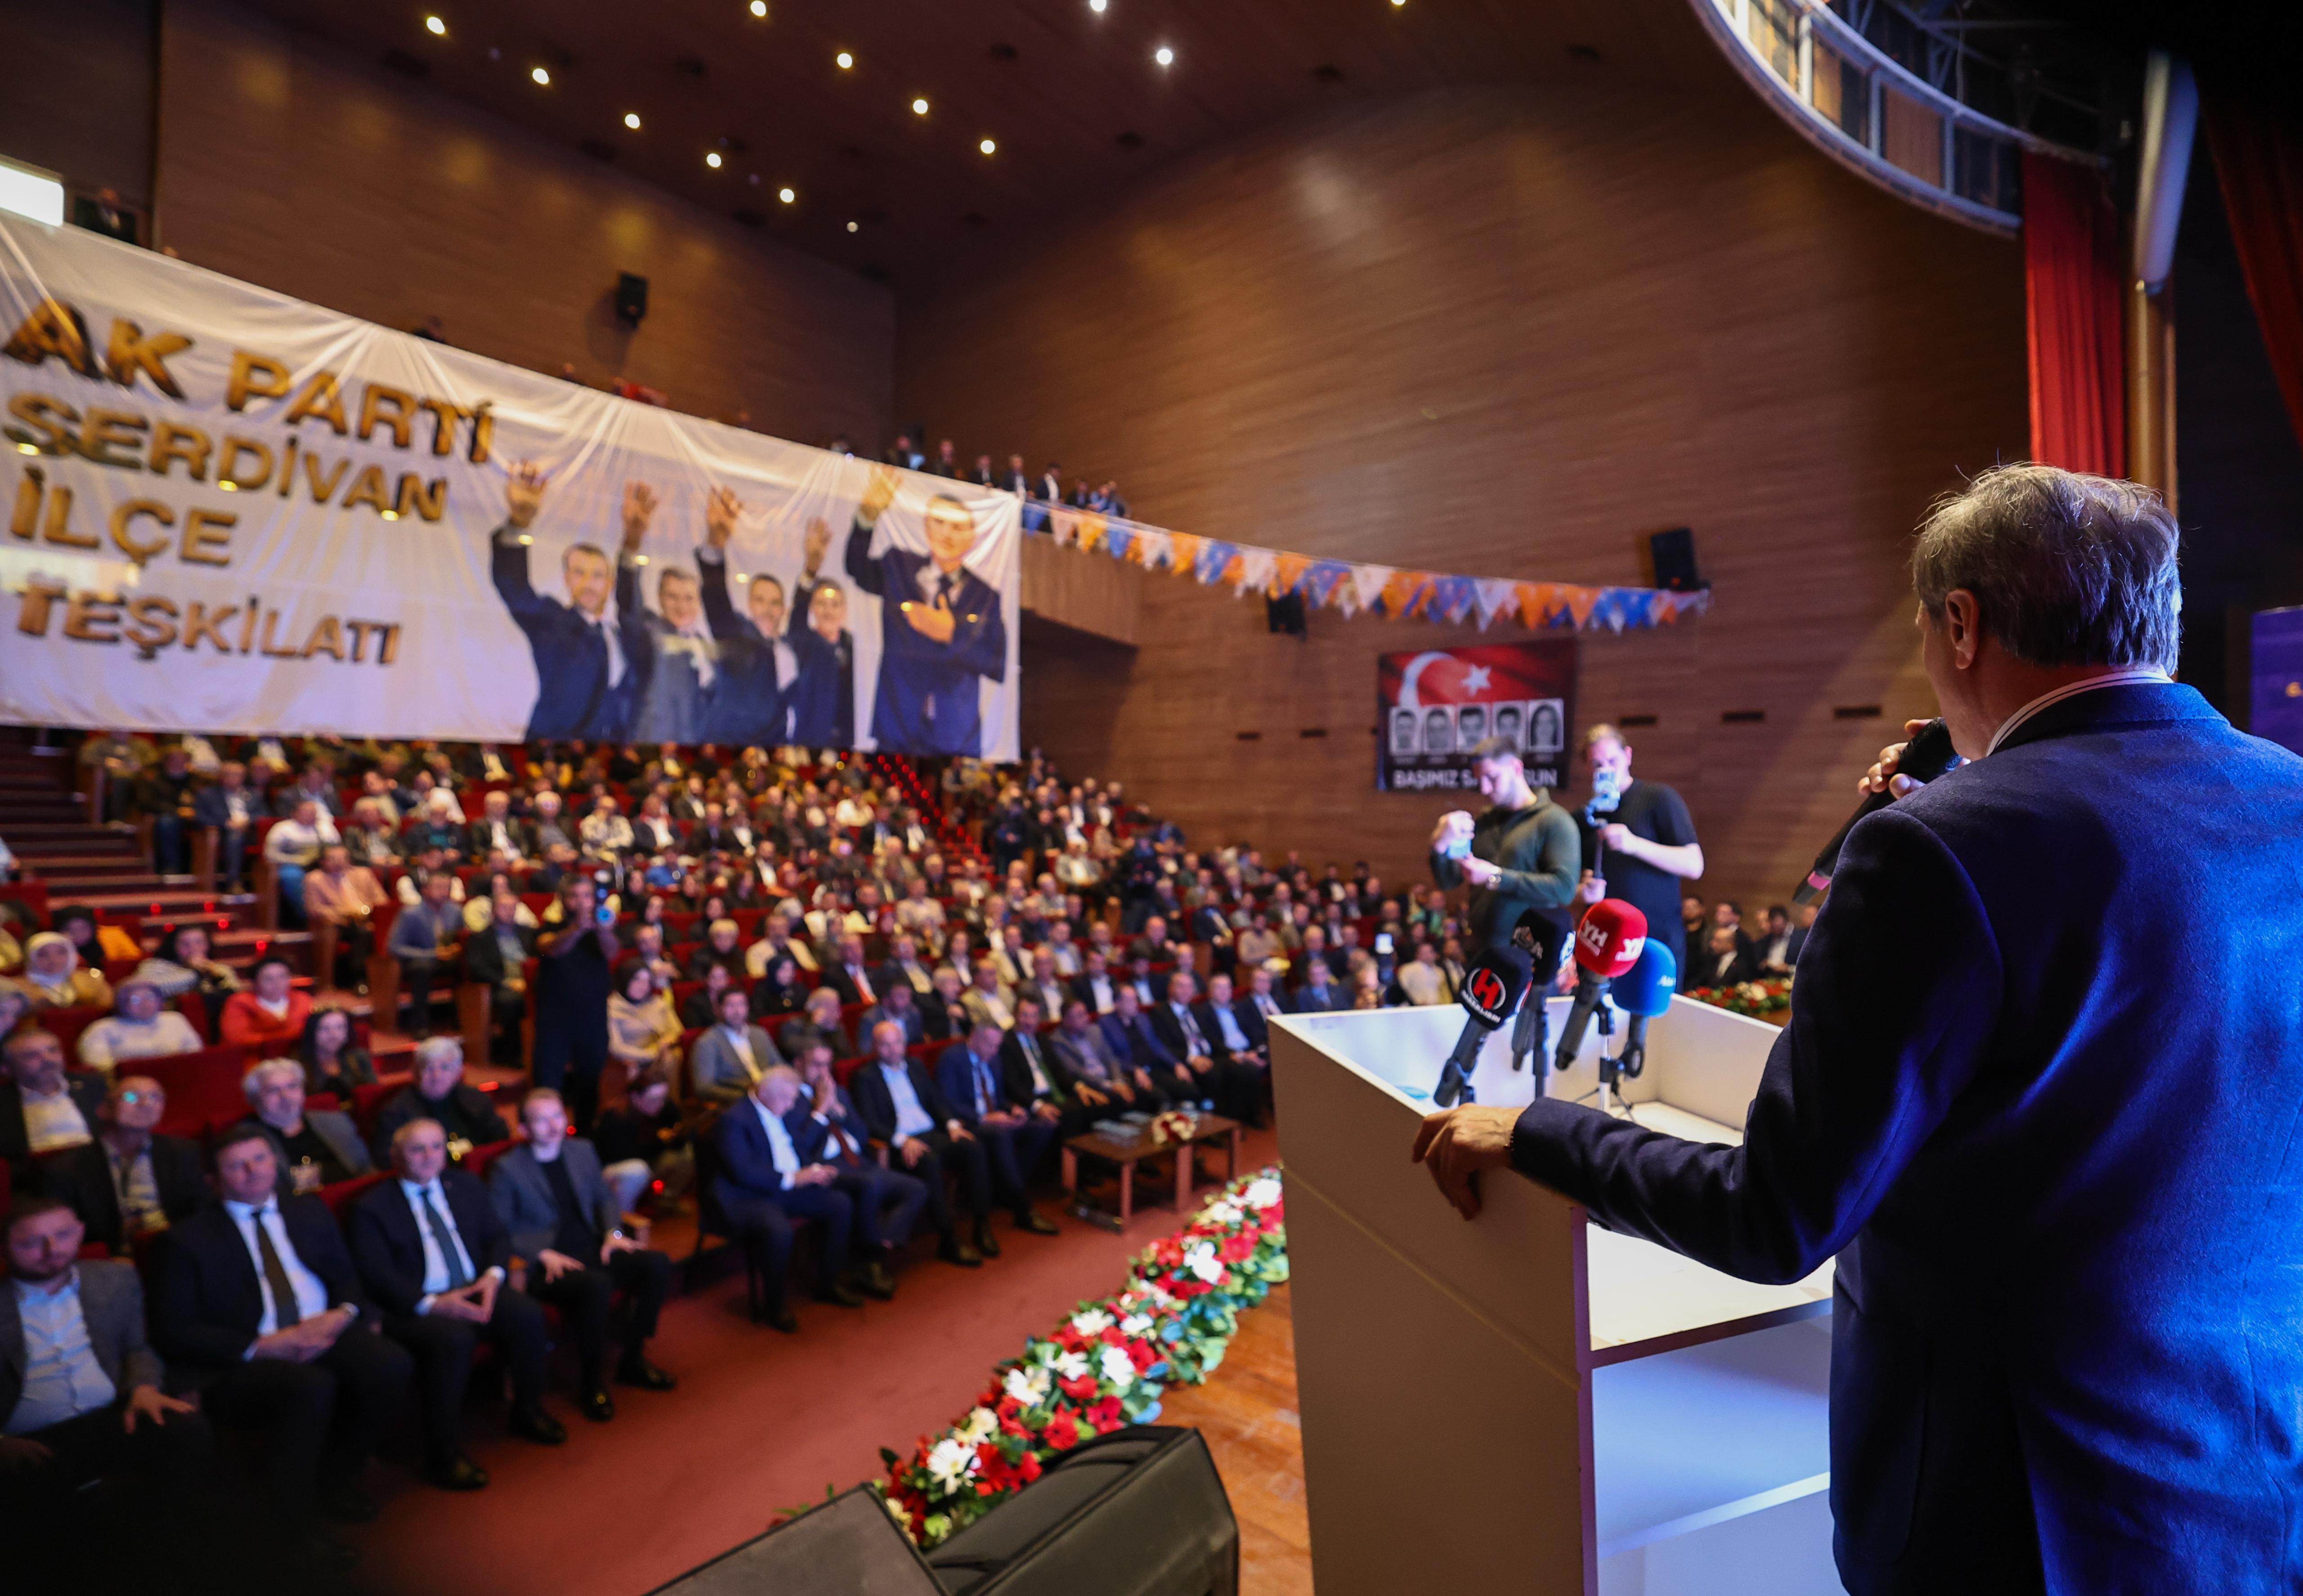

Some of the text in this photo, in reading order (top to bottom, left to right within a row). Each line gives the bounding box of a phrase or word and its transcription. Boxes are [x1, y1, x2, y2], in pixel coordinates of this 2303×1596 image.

[2, 298, 494, 463] AK PARTİ
[3, 391, 447, 522] SERDİVAN
[10, 464, 237, 566] İLÇE
[16, 582, 400, 665] TEŞKİLATI
